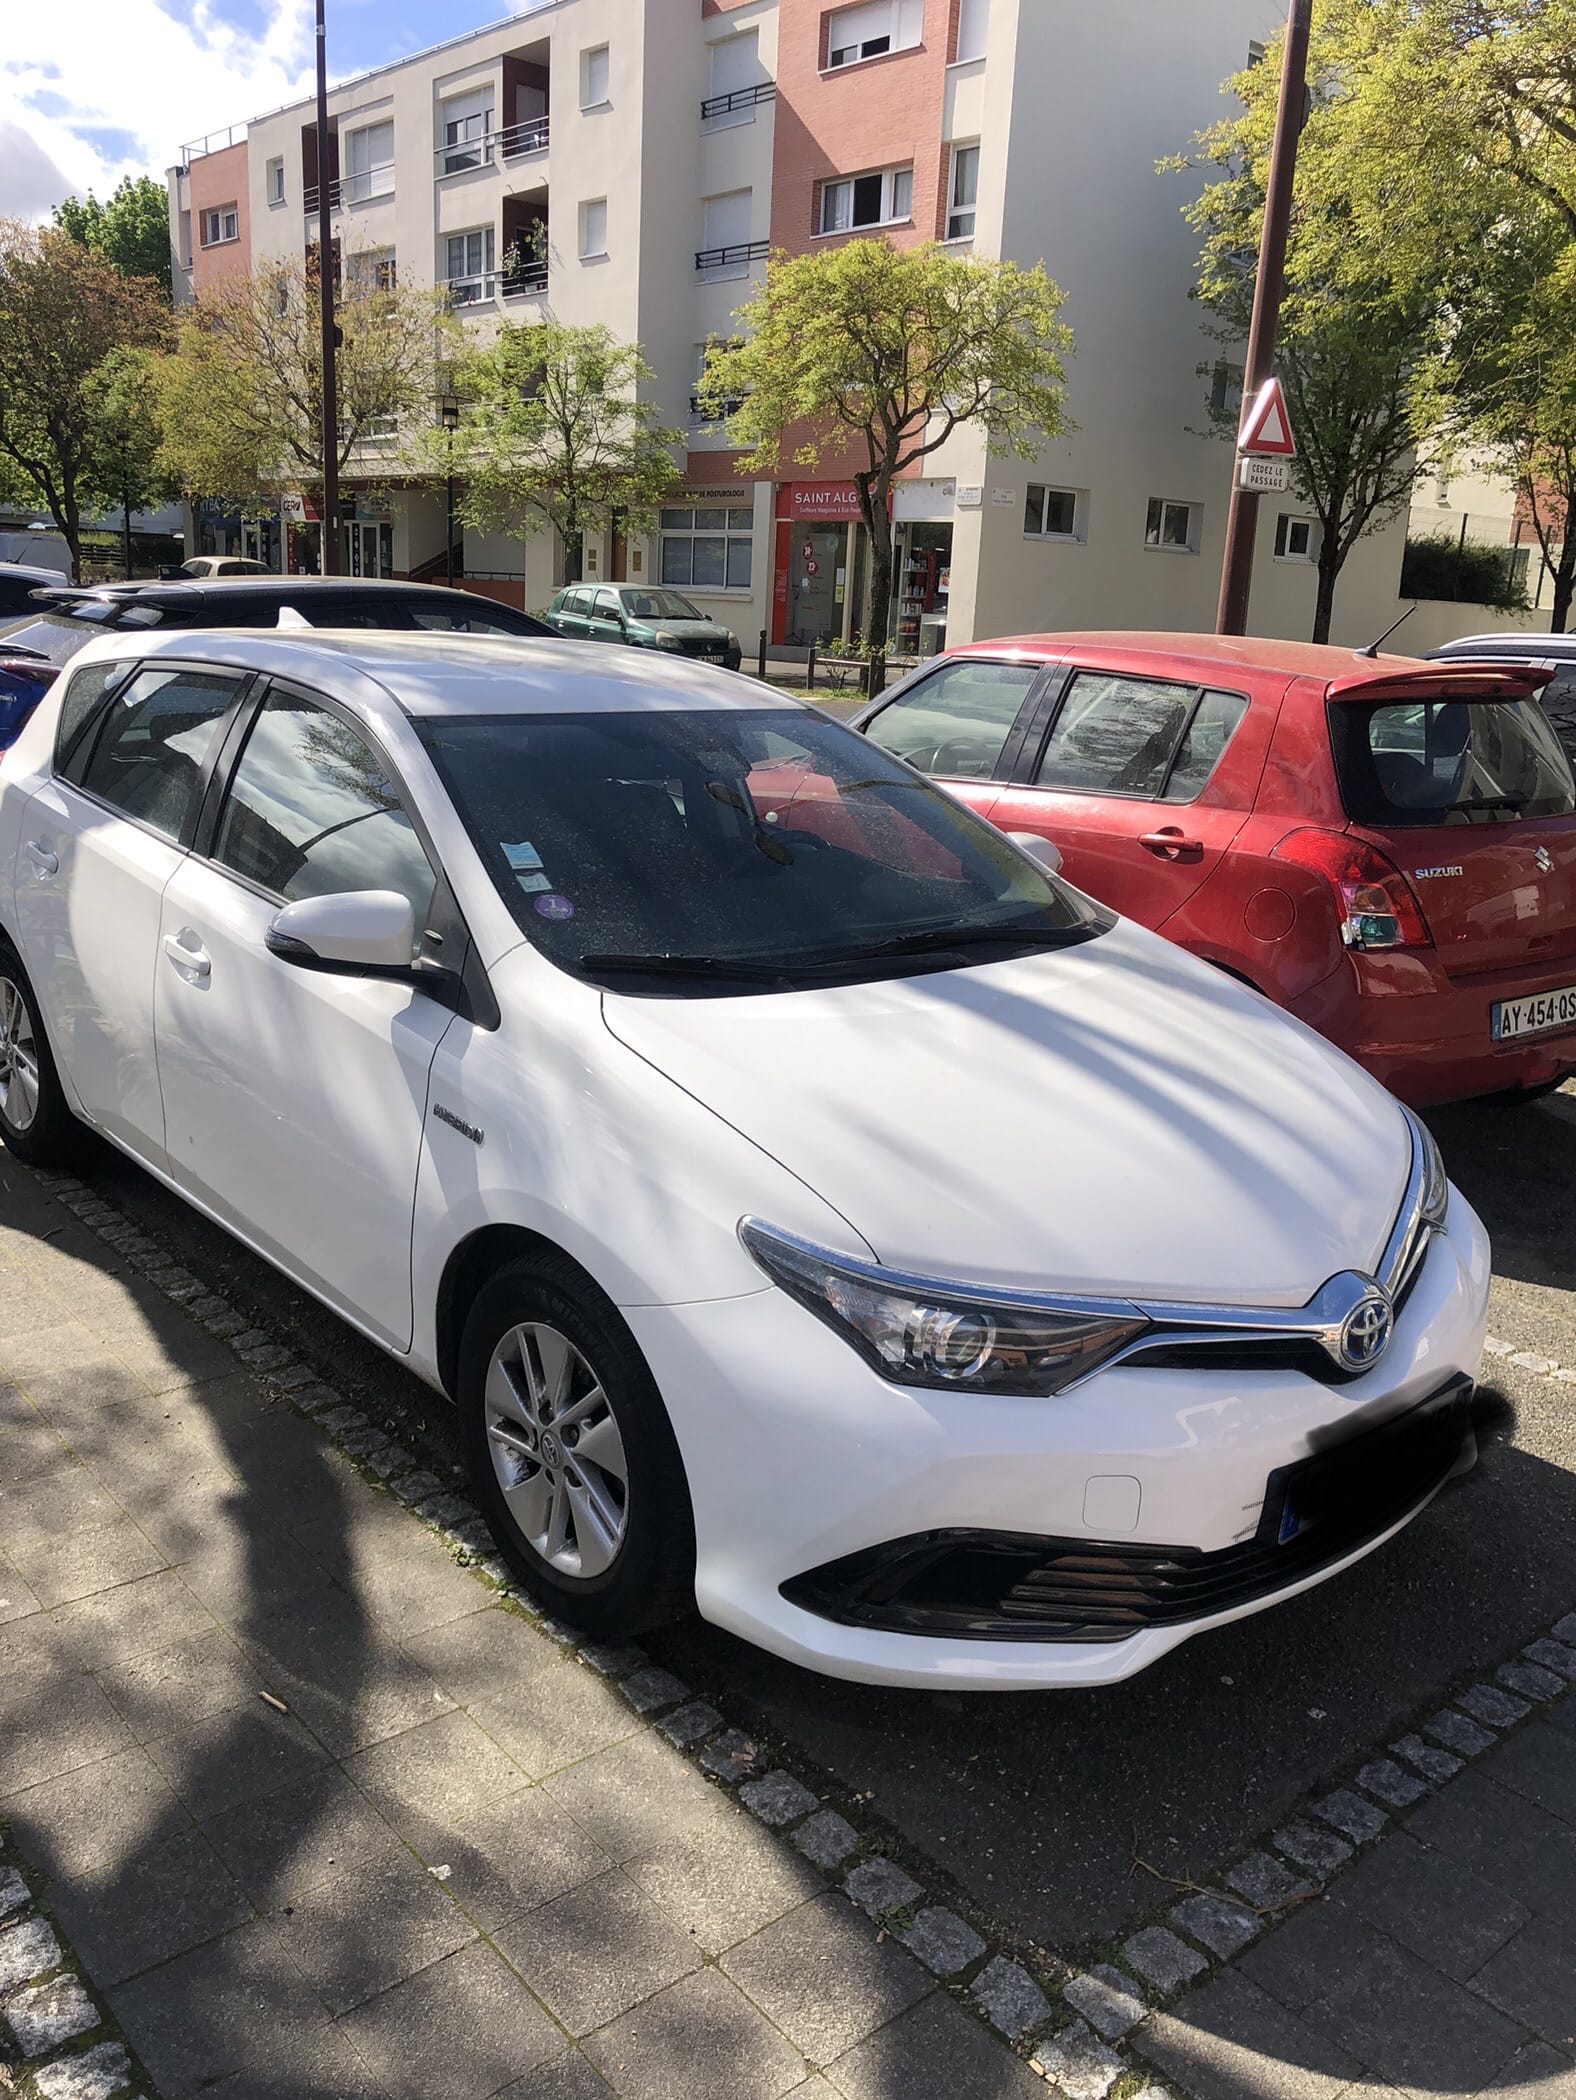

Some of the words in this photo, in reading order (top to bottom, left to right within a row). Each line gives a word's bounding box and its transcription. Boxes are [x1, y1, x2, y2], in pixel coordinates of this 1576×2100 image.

[1252, 464, 1273, 475] CEDEZ
[1275, 467, 1283, 476] LE
[1250, 475, 1282, 487] PASSAGE
[794, 492, 831, 504] SAINT
[832, 491, 860, 503] ALG
[1415, 866, 1463, 879] SUZUKI
